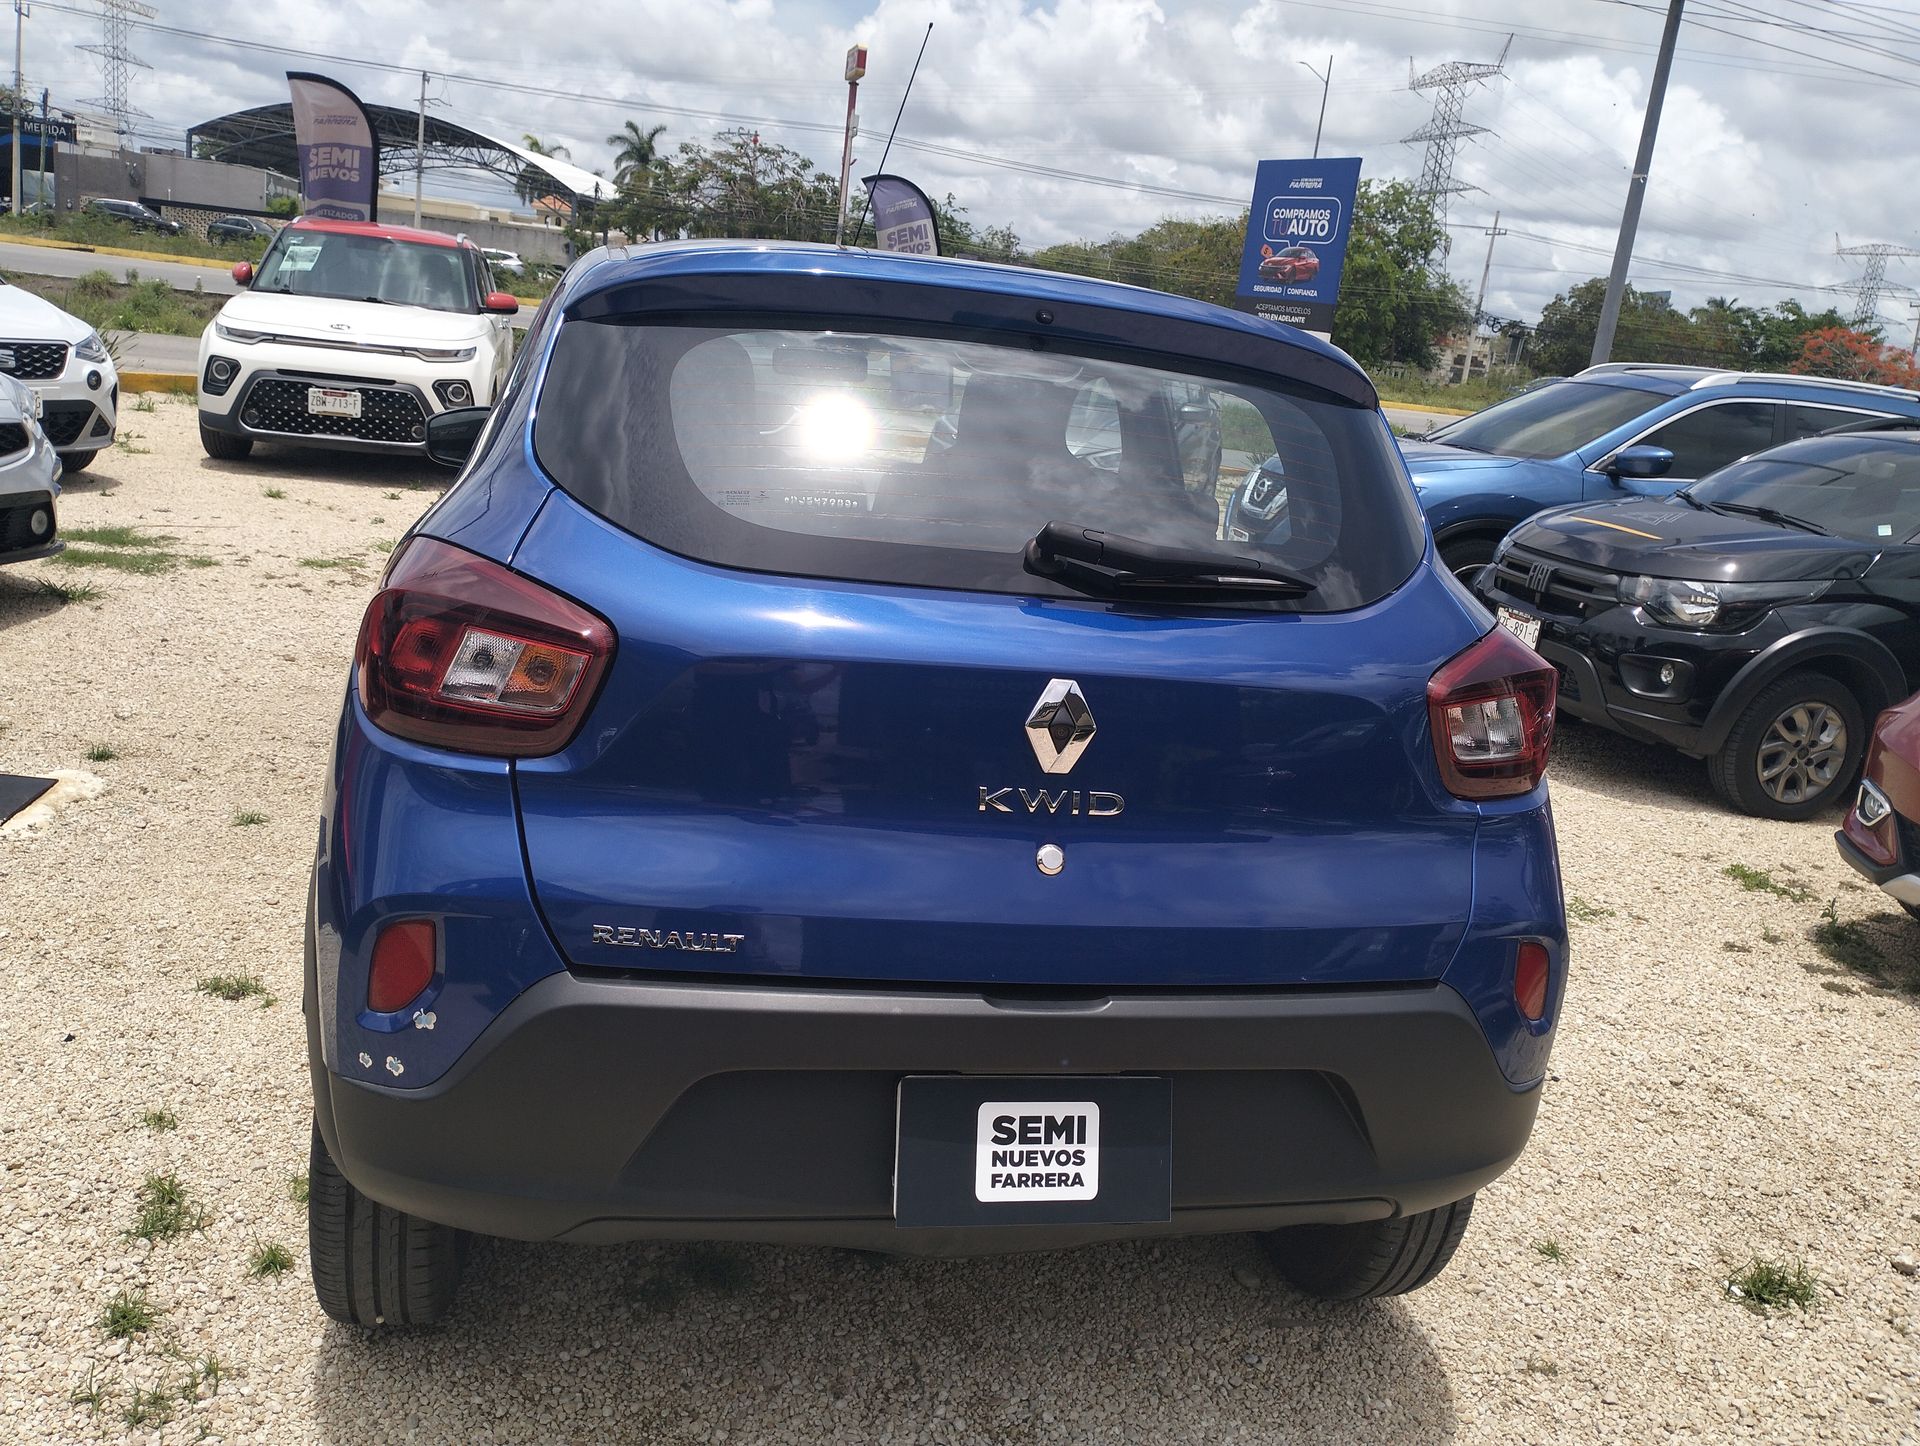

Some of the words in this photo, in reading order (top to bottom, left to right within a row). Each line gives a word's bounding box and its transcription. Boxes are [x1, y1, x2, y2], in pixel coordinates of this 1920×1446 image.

[309, 147, 360, 168] SEMI
[308, 167, 360, 182] NUEVOS
[1273, 208, 1331, 220] COMPRAMOS
[887, 224, 928, 250] SEMI
[1253, 284, 1282, 294] SEGURIDAD
[1286, 288, 1318, 297] CONFIANZA
[1255, 303, 1285, 313] ACEPTAMOS
[1285, 306, 1312, 316] MODELOS
[1278, 314, 1306, 324] ADELANTE
[978, 786, 1125, 816] KWID
[592, 924, 745, 953] RENAULT
[990, 1115, 1087, 1146] SEMI
[991, 1150, 1086, 1168] NUEVOS
[990, 1172, 1085, 1189] FARRERA
